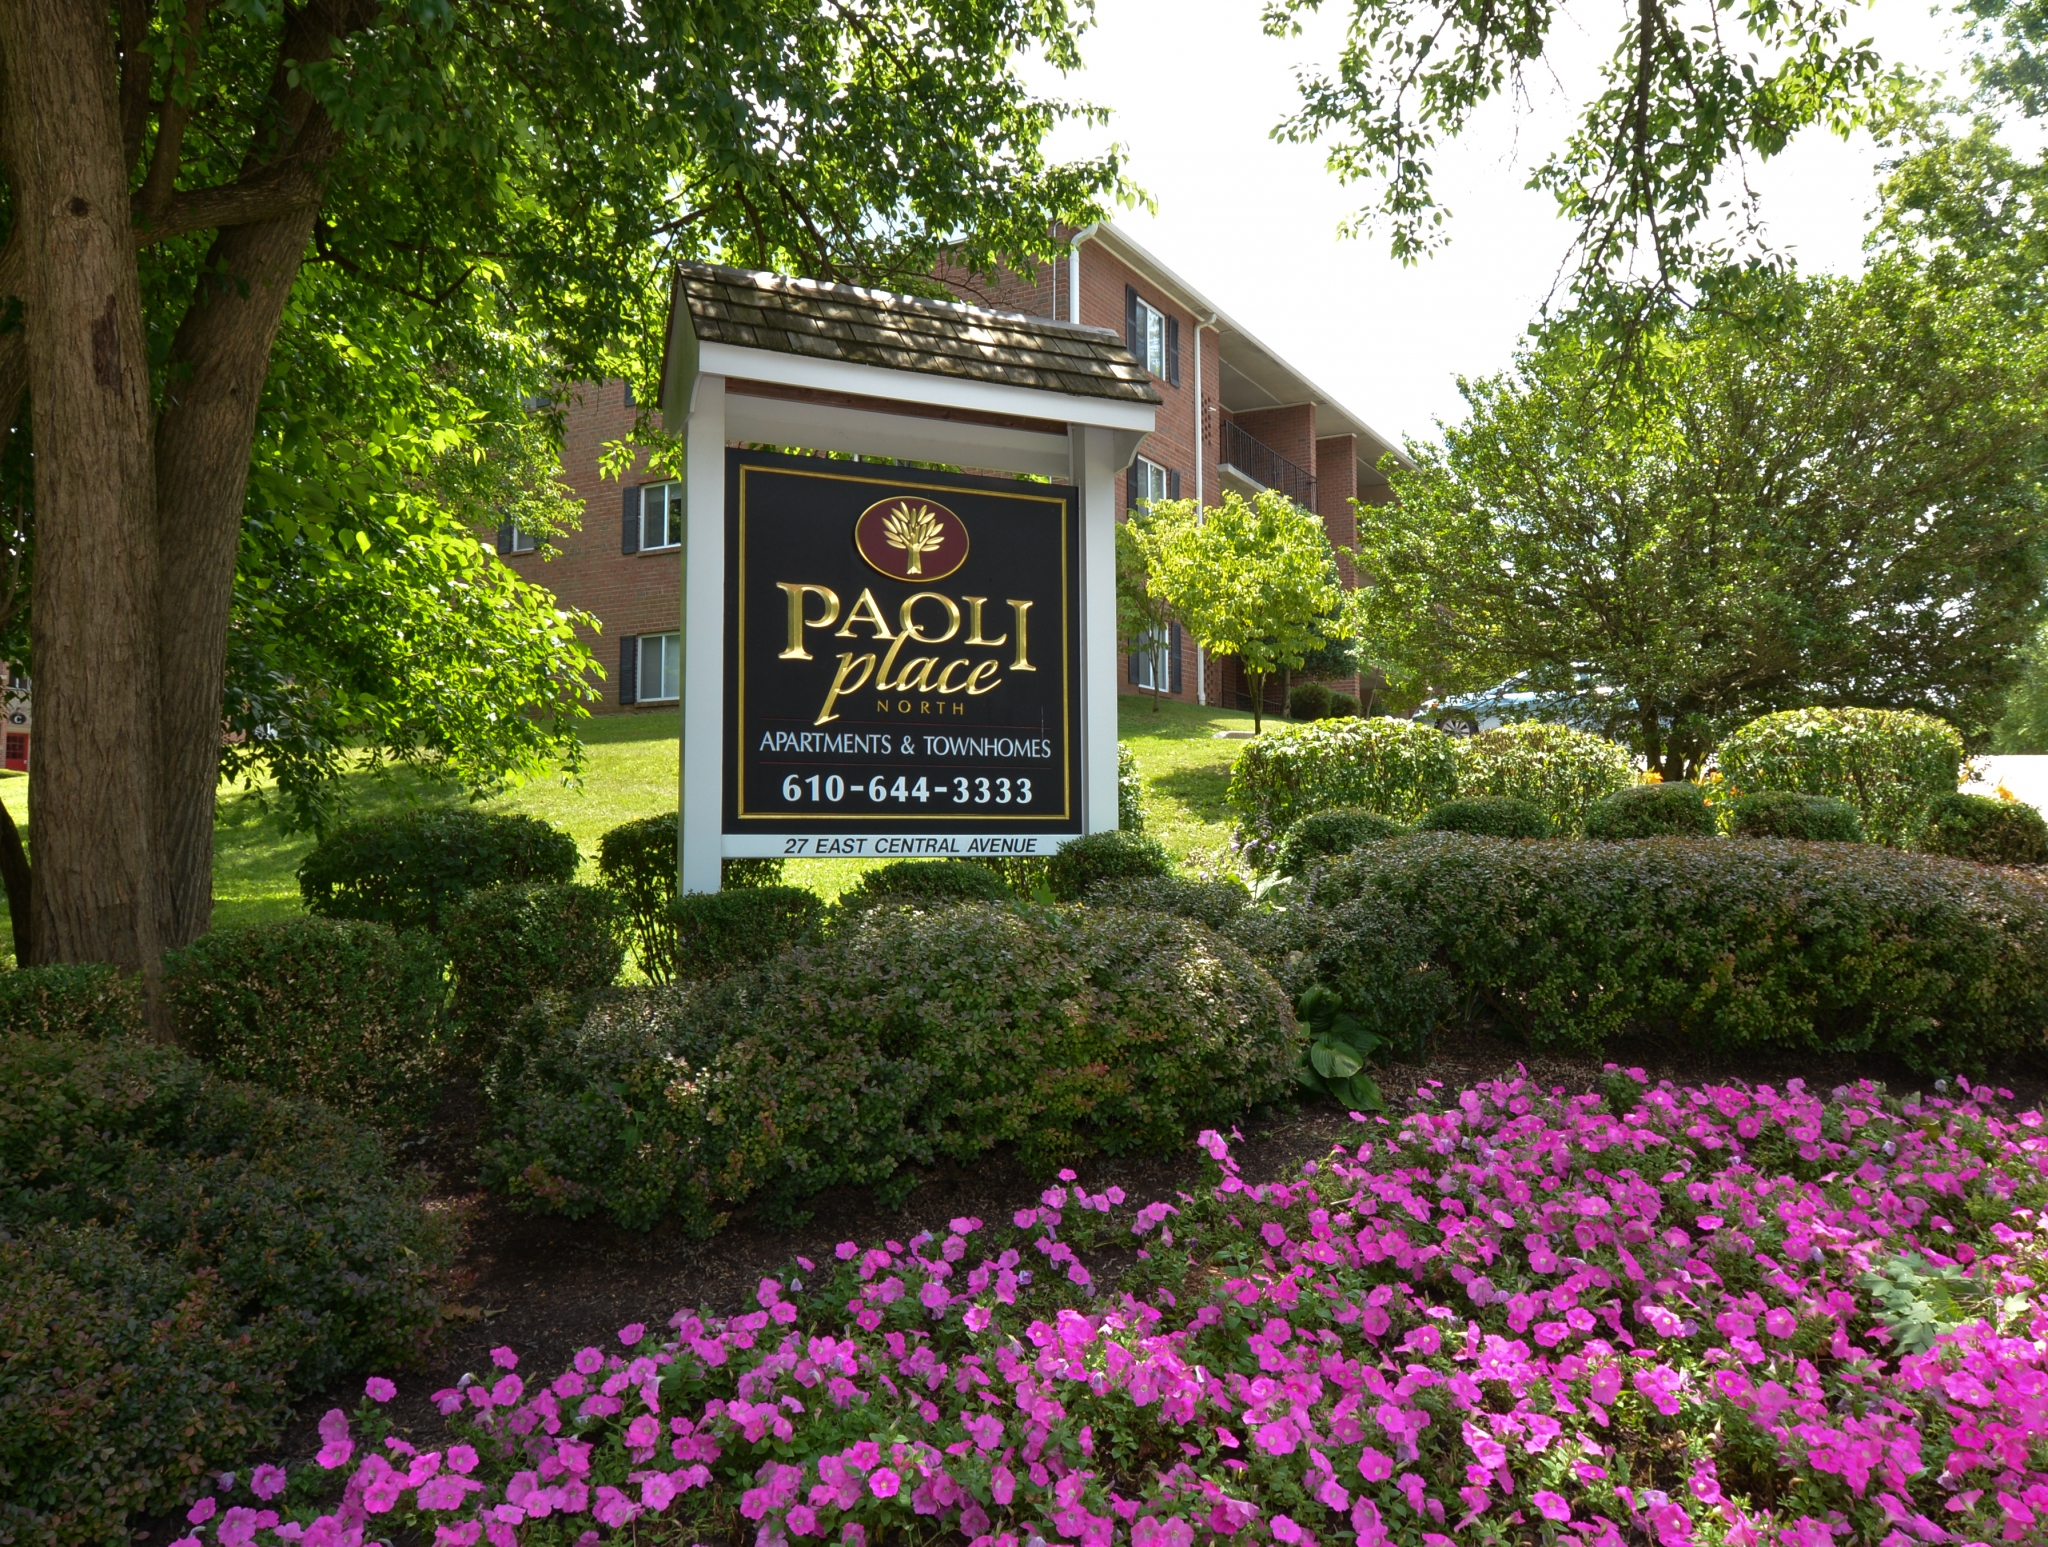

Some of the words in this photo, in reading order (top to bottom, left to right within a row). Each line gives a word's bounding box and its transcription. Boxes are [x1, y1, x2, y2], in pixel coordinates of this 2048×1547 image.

[776, 582, 1036, 671] PAOLI
[814, 624, 1001, 726] place
[877, 699, 965, 715] NORTH
[759, 731, 892, 755] APARTMENTS
[900, 735, 916, 756] &
[923, 736, 1051, 758] TOWNHOMES
[782, 774, 1033, 804] 610-644-3333
[784, 838, 809, 855] 27
[815, 838, 868, 854] EAST
[874, 838, 960, 854] CENTRAL
[967, 837, 1037, 854] AVENUE
